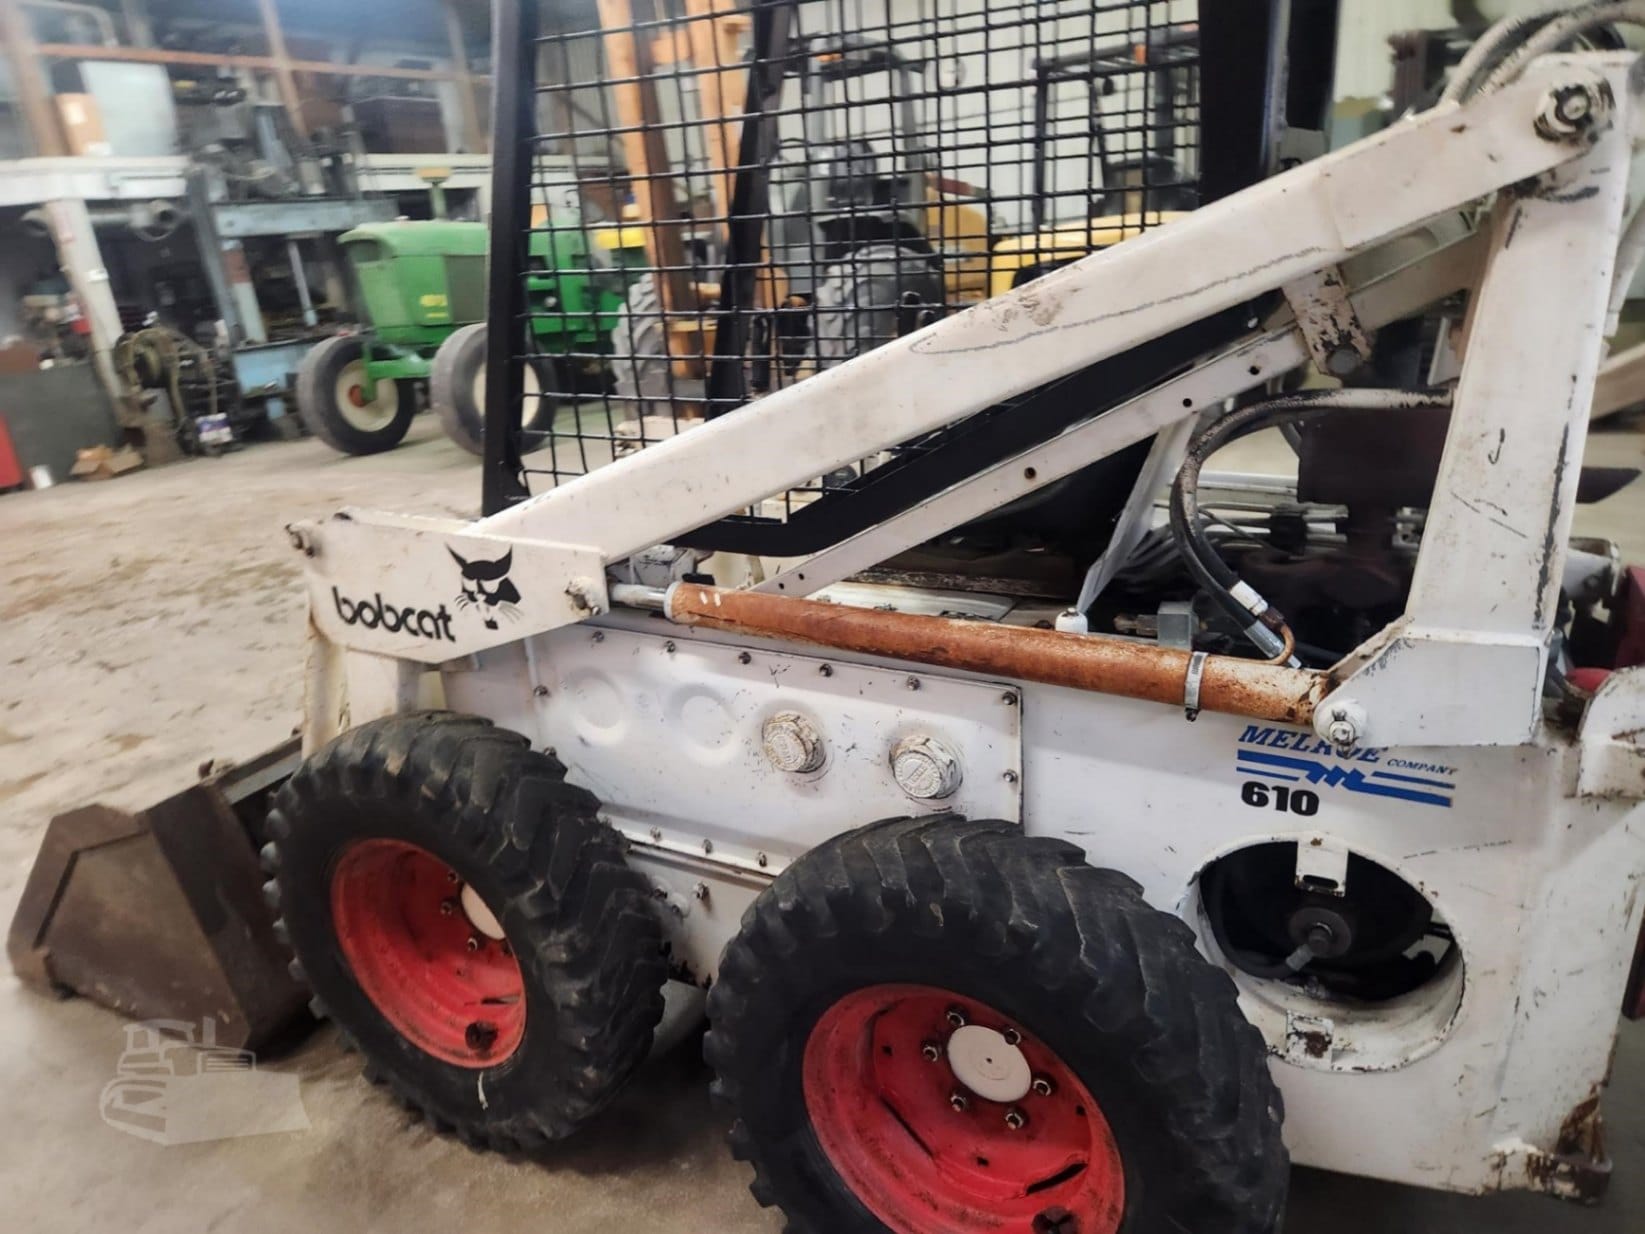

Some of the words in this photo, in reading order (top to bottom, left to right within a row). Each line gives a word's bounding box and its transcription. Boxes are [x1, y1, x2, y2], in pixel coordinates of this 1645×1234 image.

[332, 586, 456, 642] bobcat
[1387, 759, 1458, 775] COMPANY
[1241, 781, 1320, 816] 610
